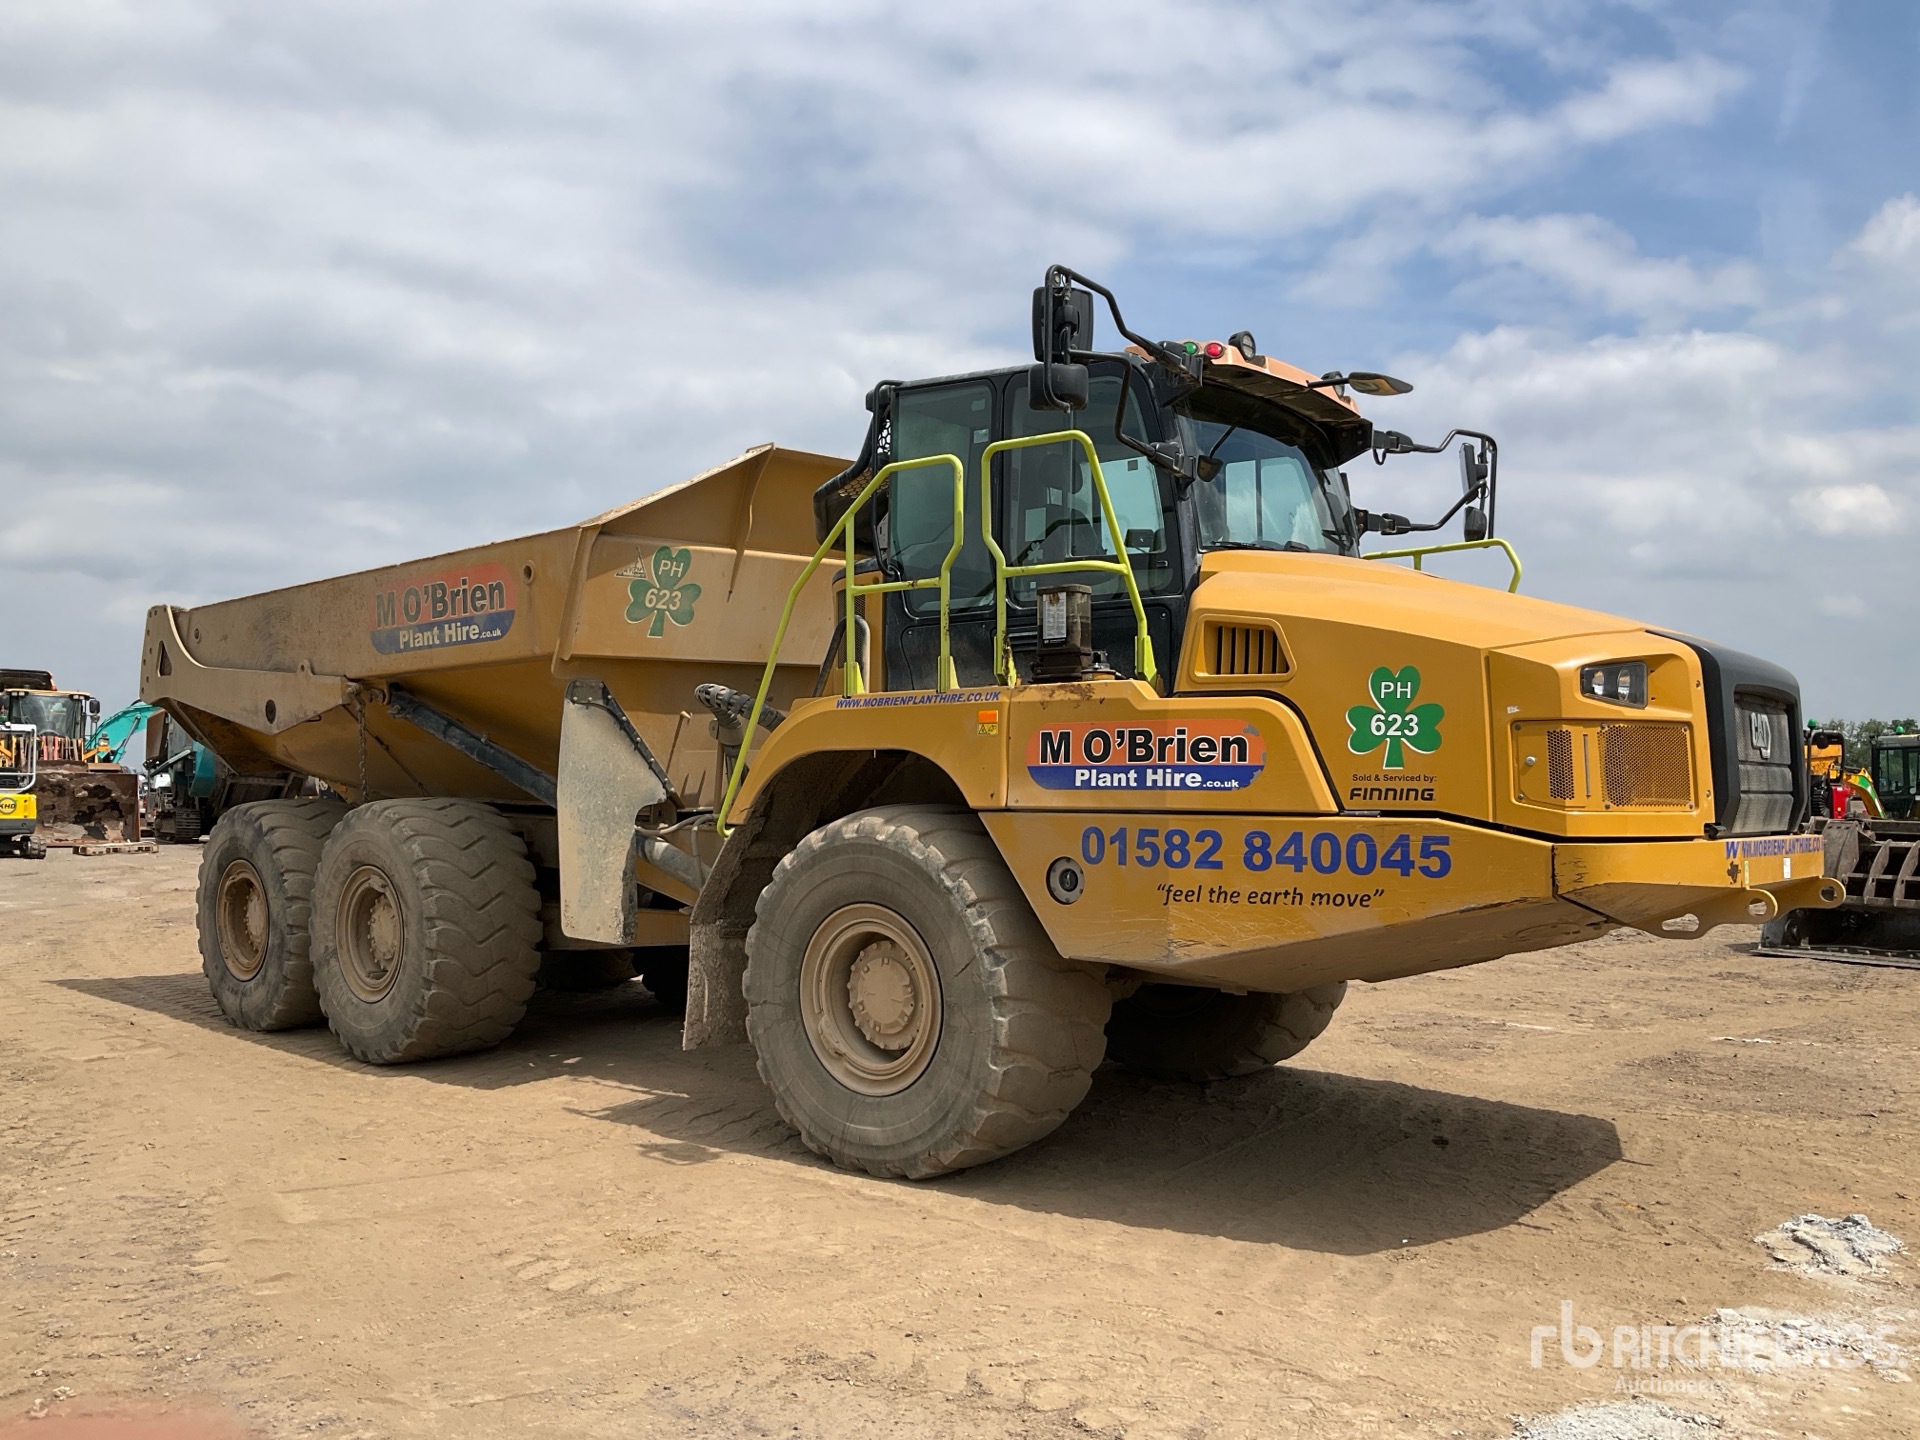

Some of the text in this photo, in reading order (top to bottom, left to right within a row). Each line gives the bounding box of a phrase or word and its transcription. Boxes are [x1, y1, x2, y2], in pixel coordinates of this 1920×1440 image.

[658, 559, 685, 578] PH
[375, 576, 507, 629] M O’Brien
[645, 588, 682, 611] 623
[399, 626, 440, 650] Plant
[836, 691, 1002, 709] WWW.MOBRIENPLANTHIRE.CO.UK
[1379, 681, 1412, 699] PH
[1370, 713, 1419, 736] 623
[1039, 727, 1249, 765] M O’Brien
[1075, 769, 1138, 787] Plant
[1352, 773, 1437, 784] Sold & Serviced by:
[1349, 787, 1435, 802] FINNING
[1081, 826, 1453, 879] 01582 840045
[1156, 884, 1385, 909] “feel the earth move”
